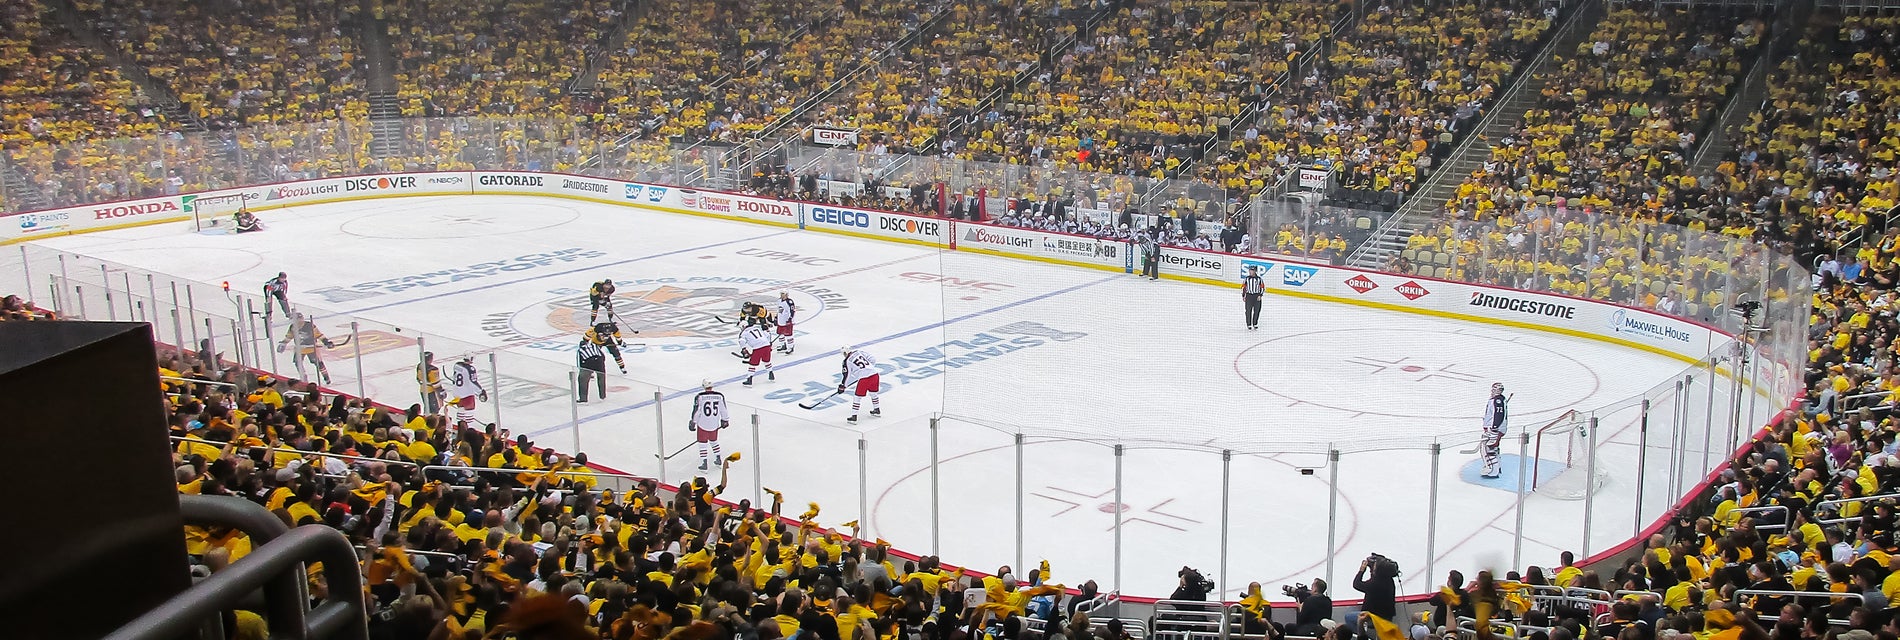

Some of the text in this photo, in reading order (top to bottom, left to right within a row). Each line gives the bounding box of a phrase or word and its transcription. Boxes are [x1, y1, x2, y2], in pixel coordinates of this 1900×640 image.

[346, 176, 416, 191] DISCOVER
[480, 175, 543, 187] GATORADE
[562, 179, 608, 193] BRIDGESTONE
[278, 184, 339, 198] Coors LIGHT
[94, 201, 178, 220] HONDA
[707, 204, 731, 213] DONUTS
[737, 201, 793, 216] HONDA
[812, 207, 869, 228] GEICO
[880, 216, 939, 237] DISCOVER
[976, 228, 1033, 248] Coors LIGHT
[1159, 253, 1221, 270] nterprise
[1284, 268, 1310, 282] SAP
[1349, 280, 1373, 289] ORKIN
[1399, 286, 1424, 296] ORKIN
[1470, 292, 1575, 319] BRIDGESTONE
[749, 329, 763, 339] 17
[1625, 318, 1664, 336] MAXWELL
[1665, 326, 1689, 342] HOUSE
[853, 355, 870, 369] 53
[704, 401, 719, 416] 65
